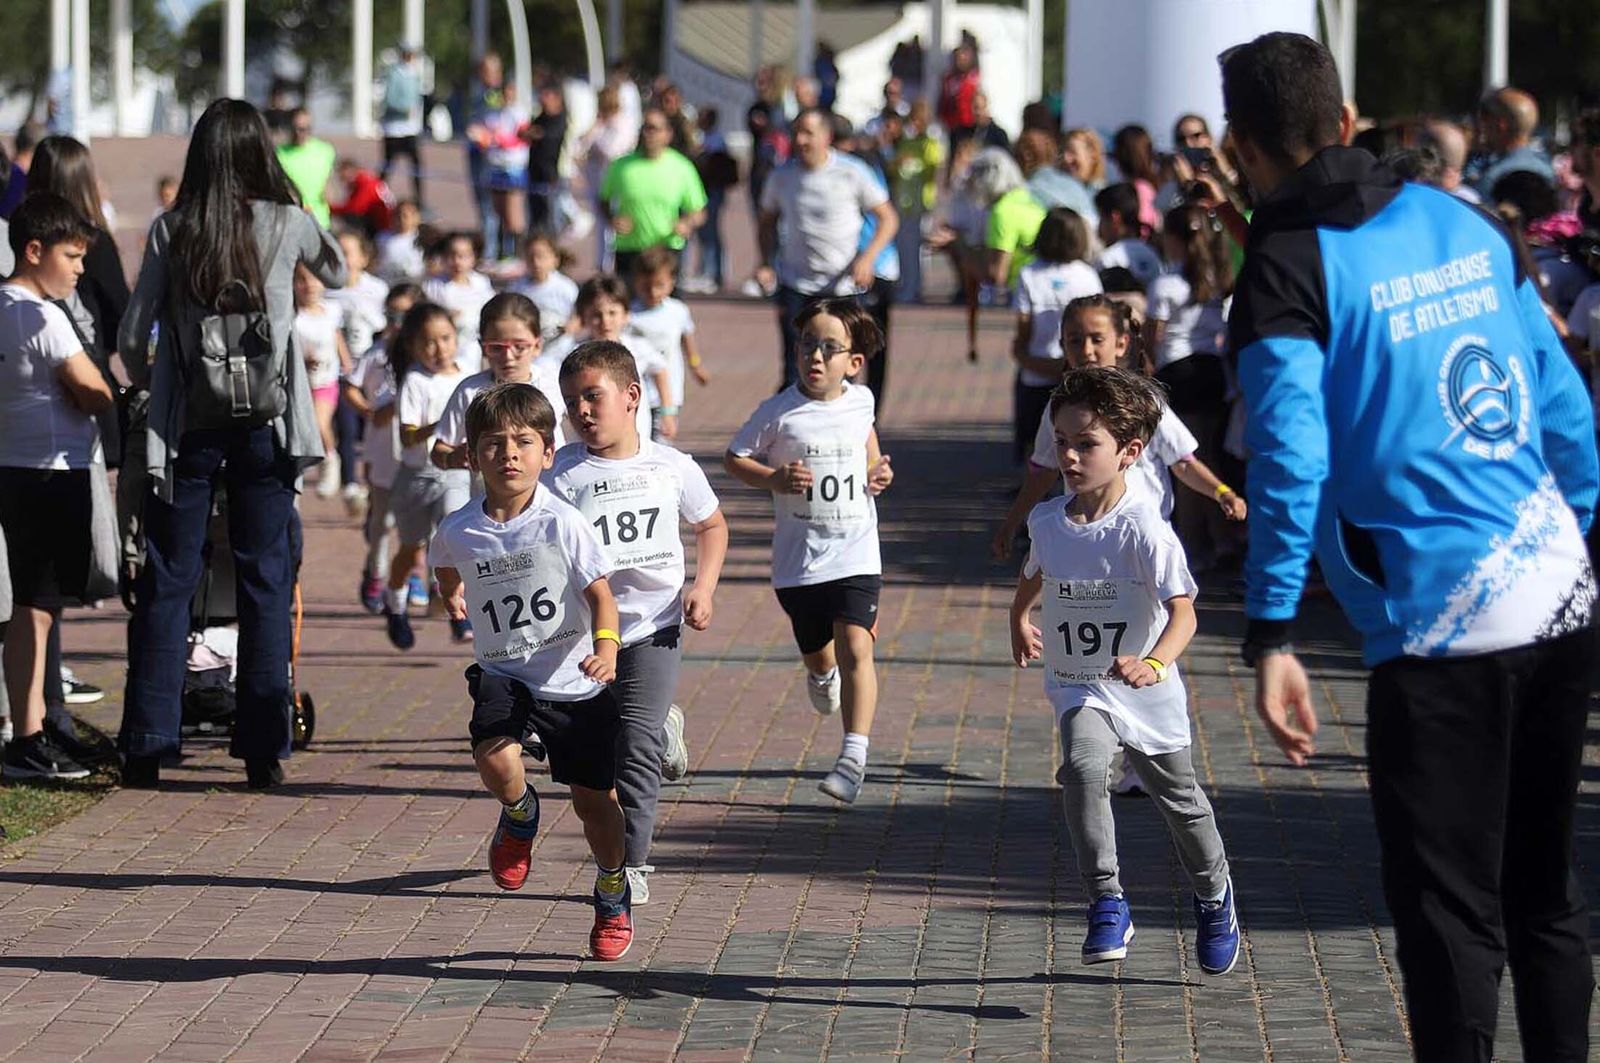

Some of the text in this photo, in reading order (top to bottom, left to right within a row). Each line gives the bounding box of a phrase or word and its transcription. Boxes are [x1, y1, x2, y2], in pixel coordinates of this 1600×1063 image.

[1370, 251, 1493, 312] CLUB ONUBENSE
[1389, 286, 1499, 343] DE ATLETISMO
[594, 481, 608, 493] H
[593, 507, 660, 546] 187
[476, 561, 492, 575] H
[1059, 583, 1072, 596] H
[481, 586, 557, 635] 126
[1057, 621, 1128, 657] 197
[483, 648, 508, 659] Huelva
[1053, 667, 1076, 680] Huelva
